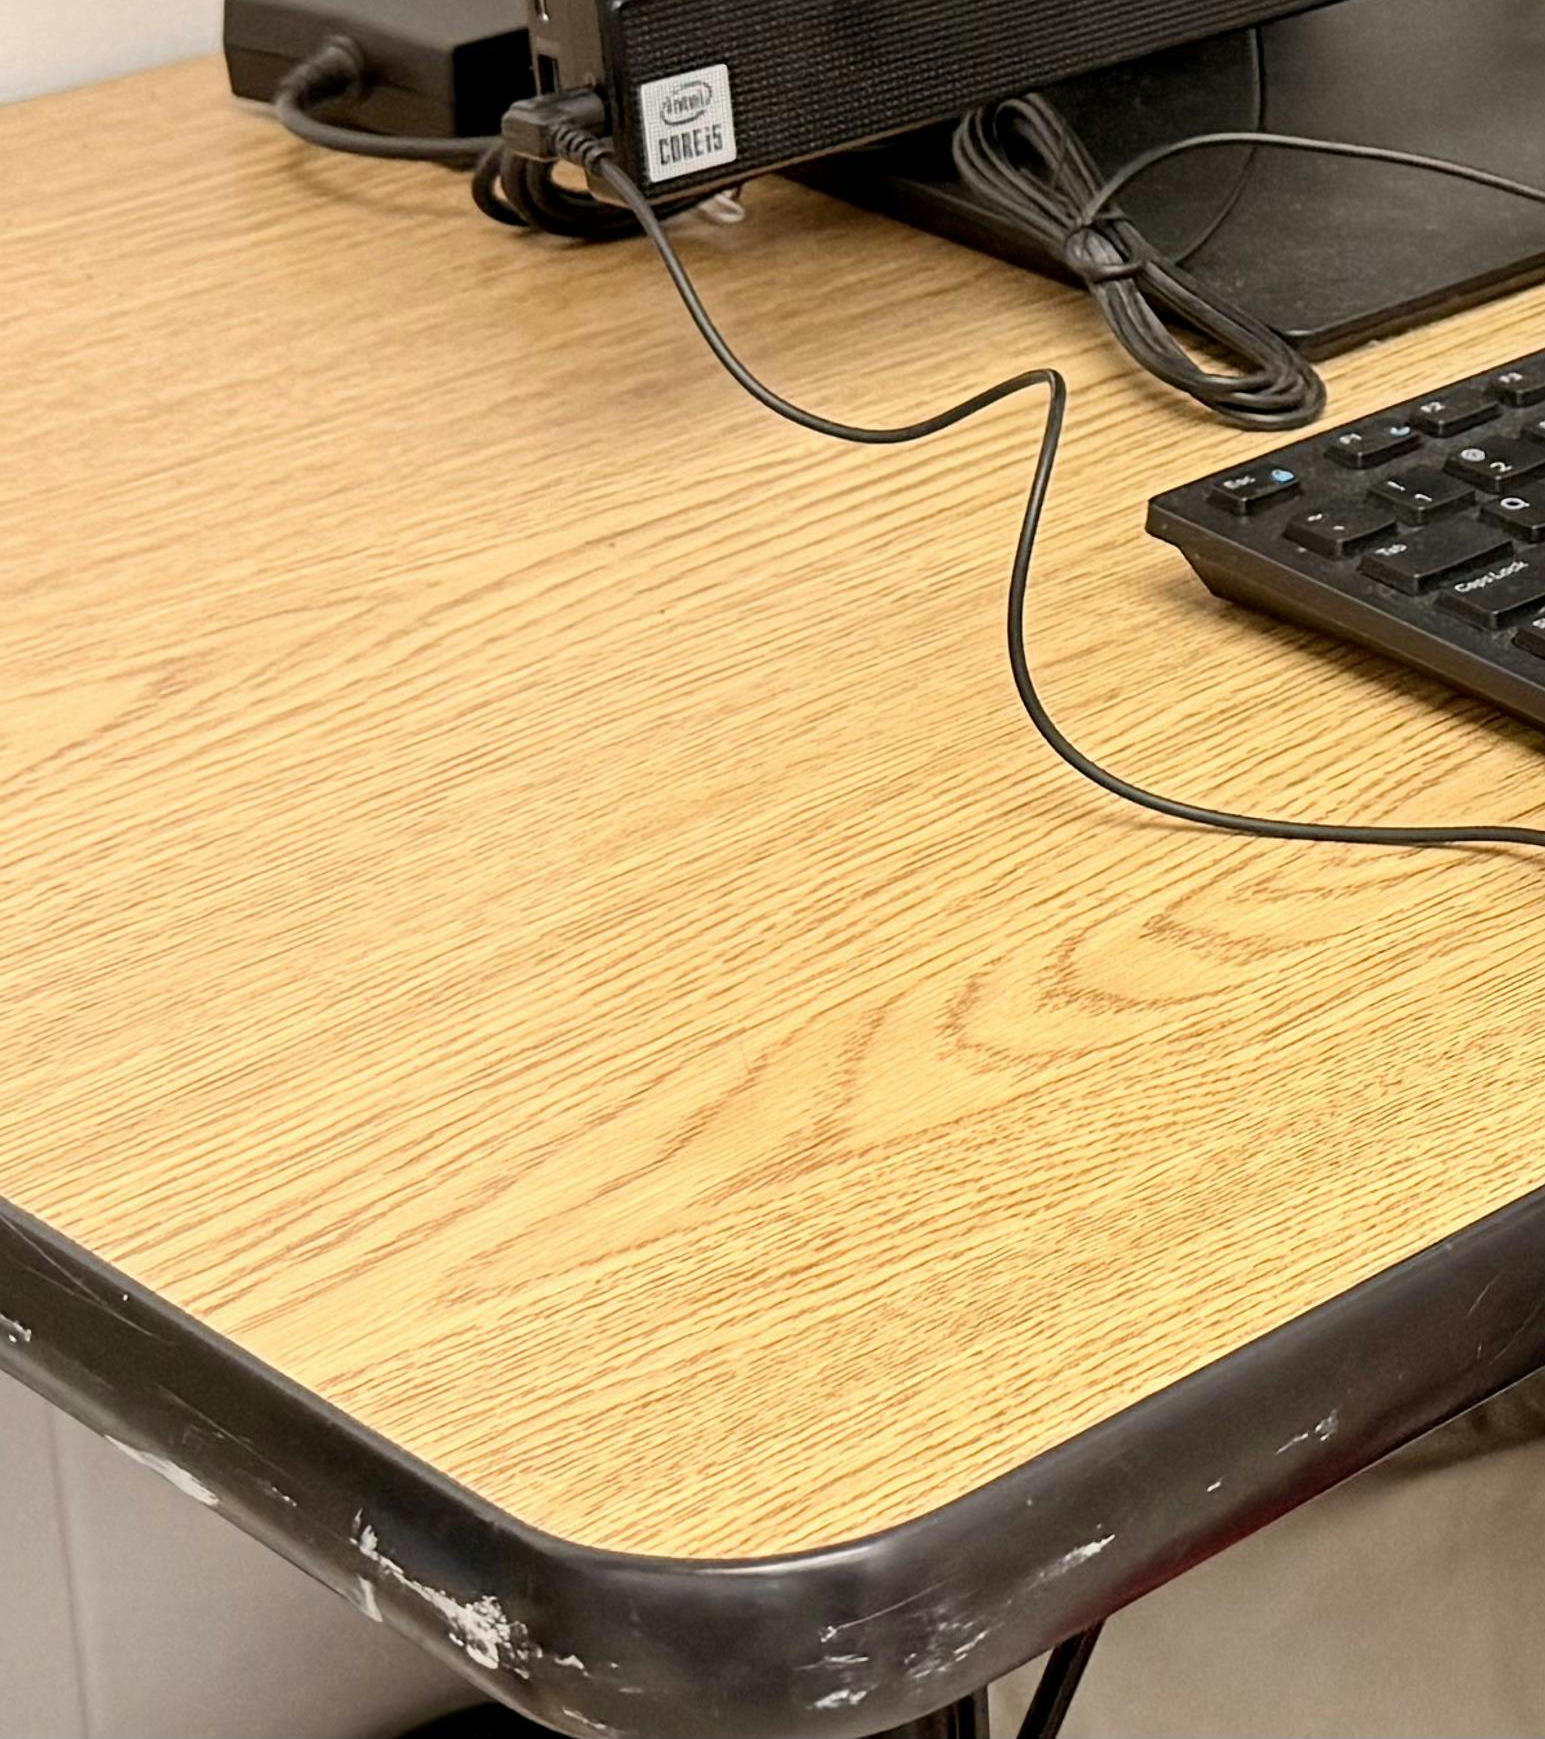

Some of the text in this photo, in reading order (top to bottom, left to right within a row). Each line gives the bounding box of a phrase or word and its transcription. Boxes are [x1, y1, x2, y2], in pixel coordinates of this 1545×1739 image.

[658, 129, 703, 166] CORE
[1490, 461, 1512, 472] 2
[1500, 497, 1530, 510] Q
